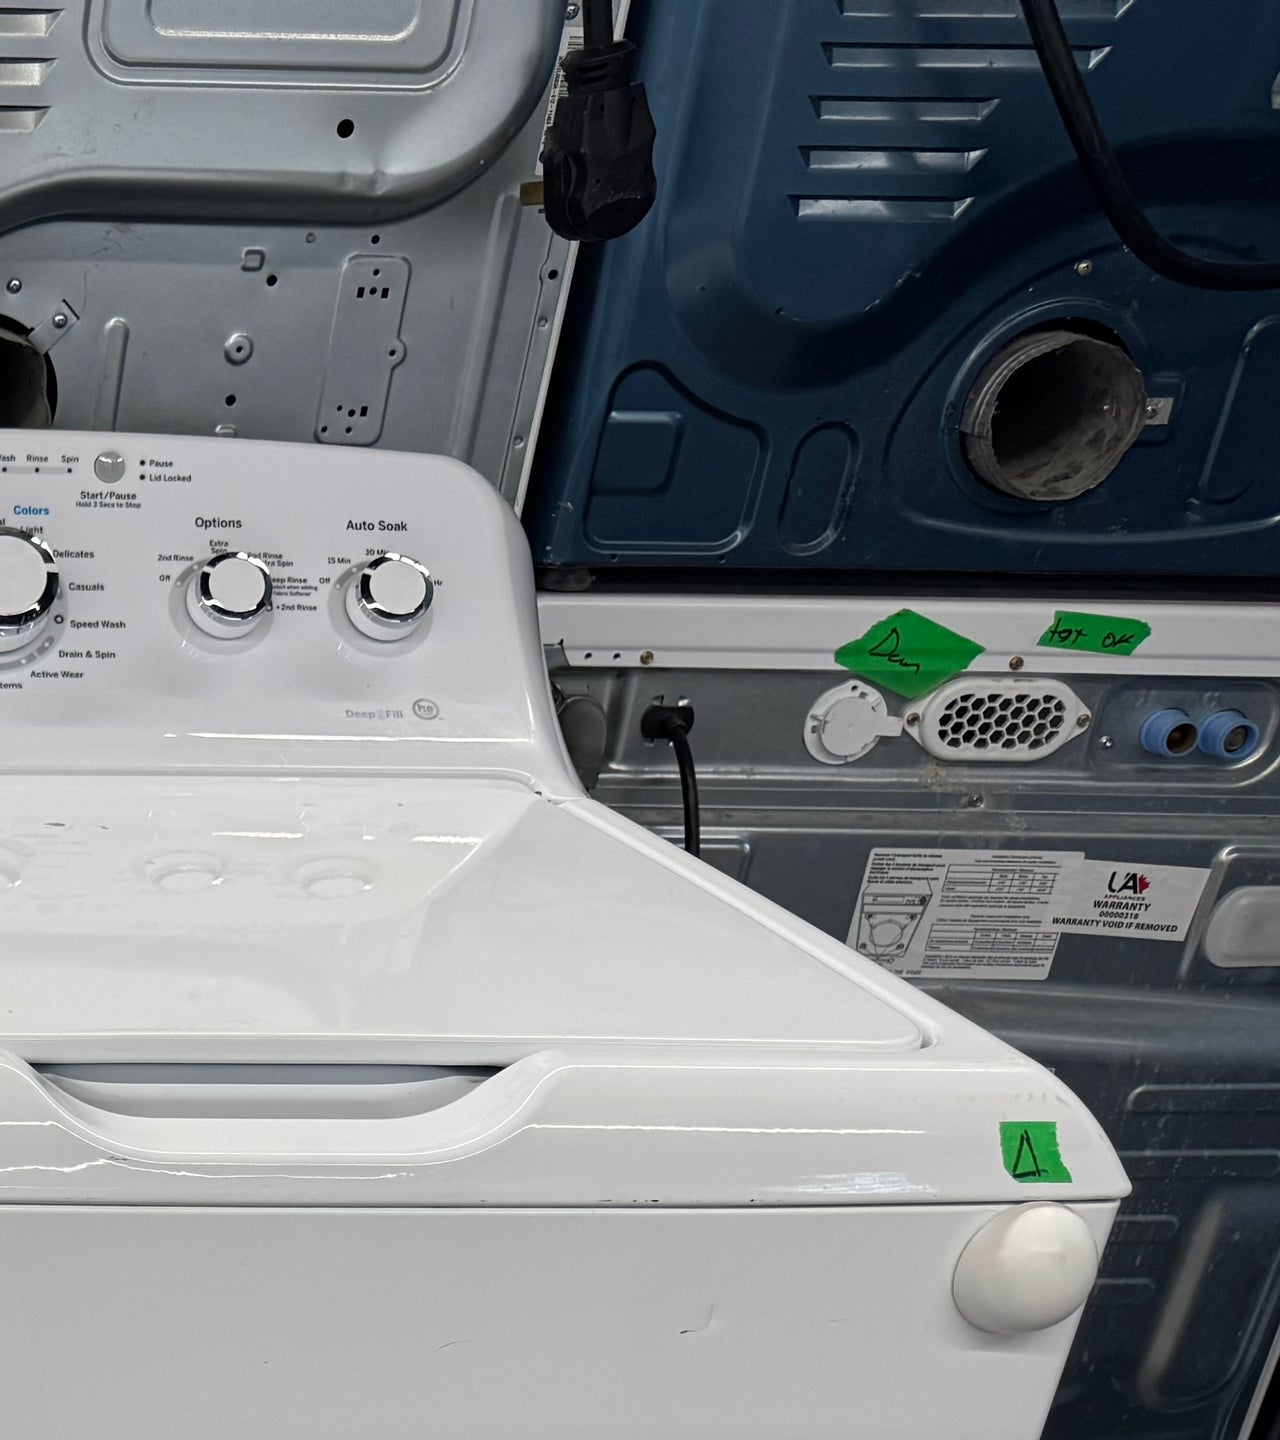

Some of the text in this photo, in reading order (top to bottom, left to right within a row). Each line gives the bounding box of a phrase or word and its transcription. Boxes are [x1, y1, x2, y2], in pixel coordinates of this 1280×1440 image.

[26, 454, 49, 463] Rinse
[61, 455, 79, 464] Spin
[149, 459, 173, 467] Pause
[149, 474, 192, 483] Lid Locked
[80, 491, 137, 501] Start/Pause
[13, 505, 50, 516] Colors
[125, 502, 142, 510] Stop
[195, 517, 242, 530] Options
[346, 519, 408, 532] Auto Soak
[20, 525, 43, 535] Light
[52, 550, 95, 559] Delicates
[173, 554, 194, 562] Rinse
[287, 576, 307, 584] Rinse
[68, 583, 105, 592] Casuals
[281, 603, 295, 611] 2nd
[70, 619, 126, 630] Speed Wash
[58, 650, 116, 660] Drain & Spin
[30, 670, 58, 678] Active
[345, 709, 403, 720] Deep Fill
[1093, 900, 1151, 912] WARRANTY
[1052, 917, 1101, 927] WARRANTY
[1102, 919, 1124, 929] VOID
[1125, 920, 1133, 929] IF
[1135, 921, 1178, 933] REMOVED
